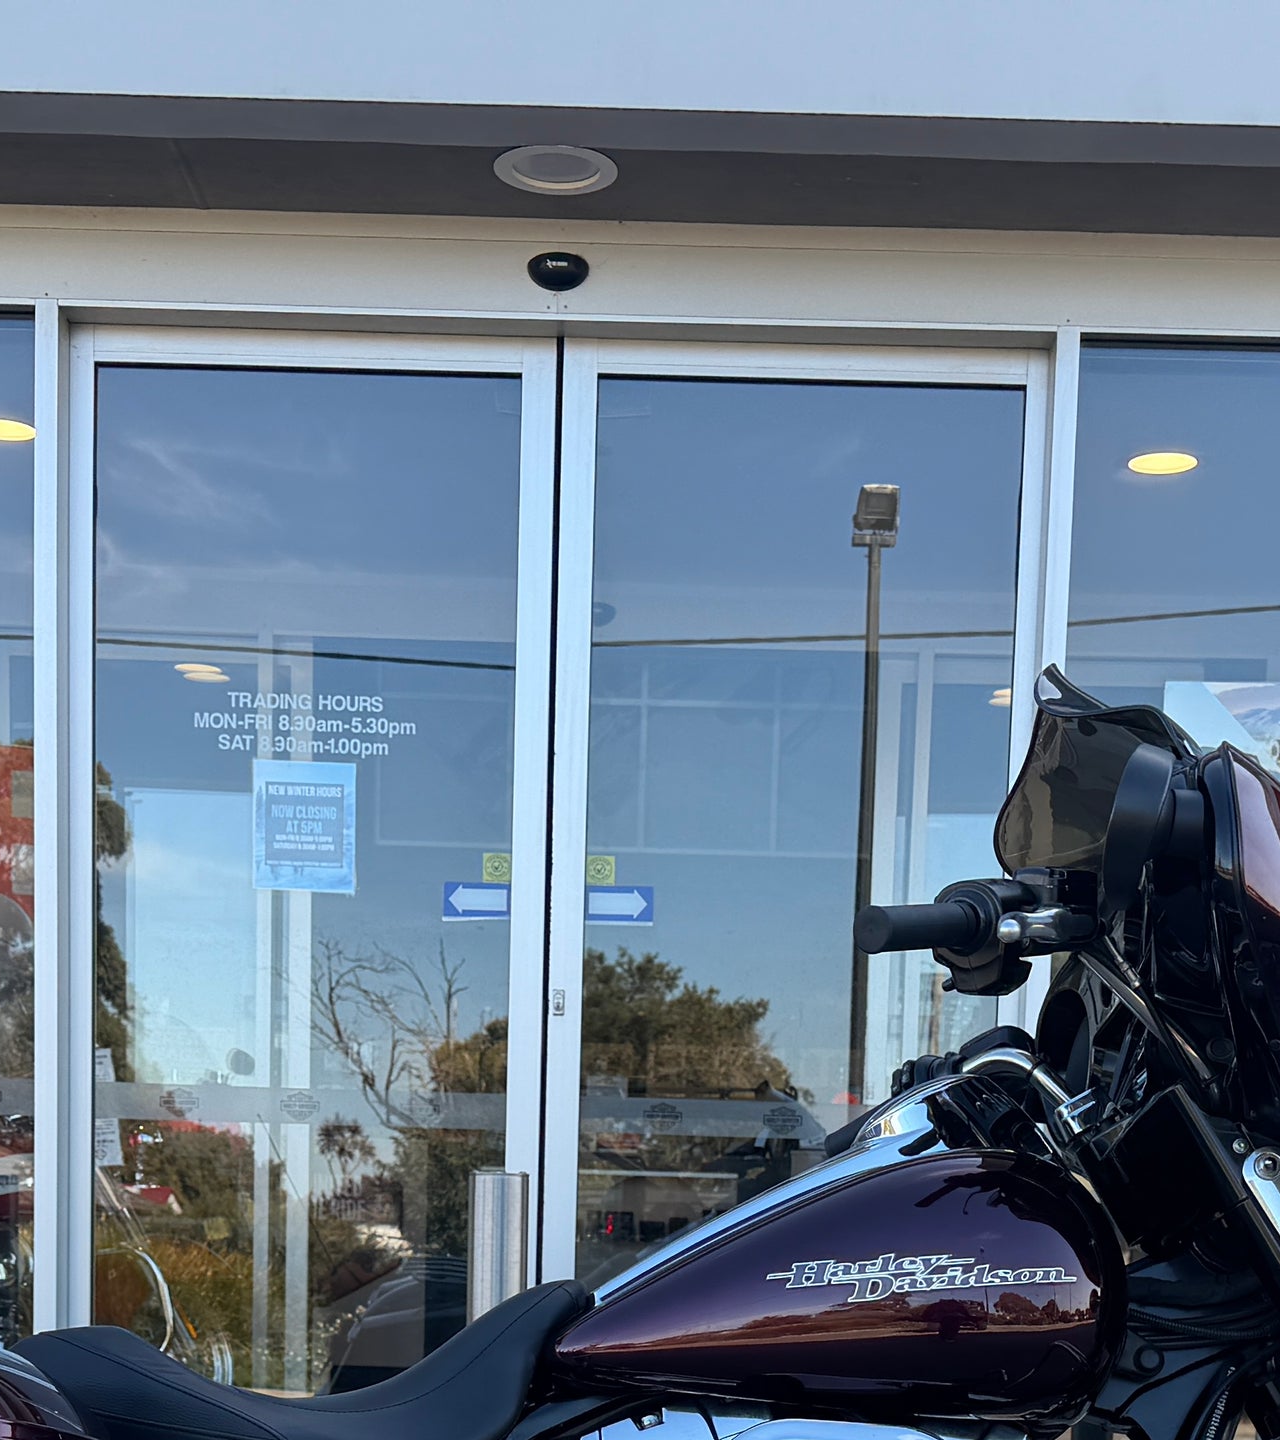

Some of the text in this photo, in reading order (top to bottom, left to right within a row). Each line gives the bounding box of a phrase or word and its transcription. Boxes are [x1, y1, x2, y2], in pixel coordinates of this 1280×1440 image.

[228, 692, 384, 713] TRADING HOURS
[194, 712, 416, 738] MON-FRI 8.30am-5.30pm
[218, 734, 254, 750] SAT
[268, 785, 342, 798] NEW WINTER HOURS
[271, 804, 337, 820] NOW CLOSING
[286, 820, 322, 834] AT 5PM
[766, 1253, 975, 1289] Harley
[830, 1264, 1077, 1303] Davidson
